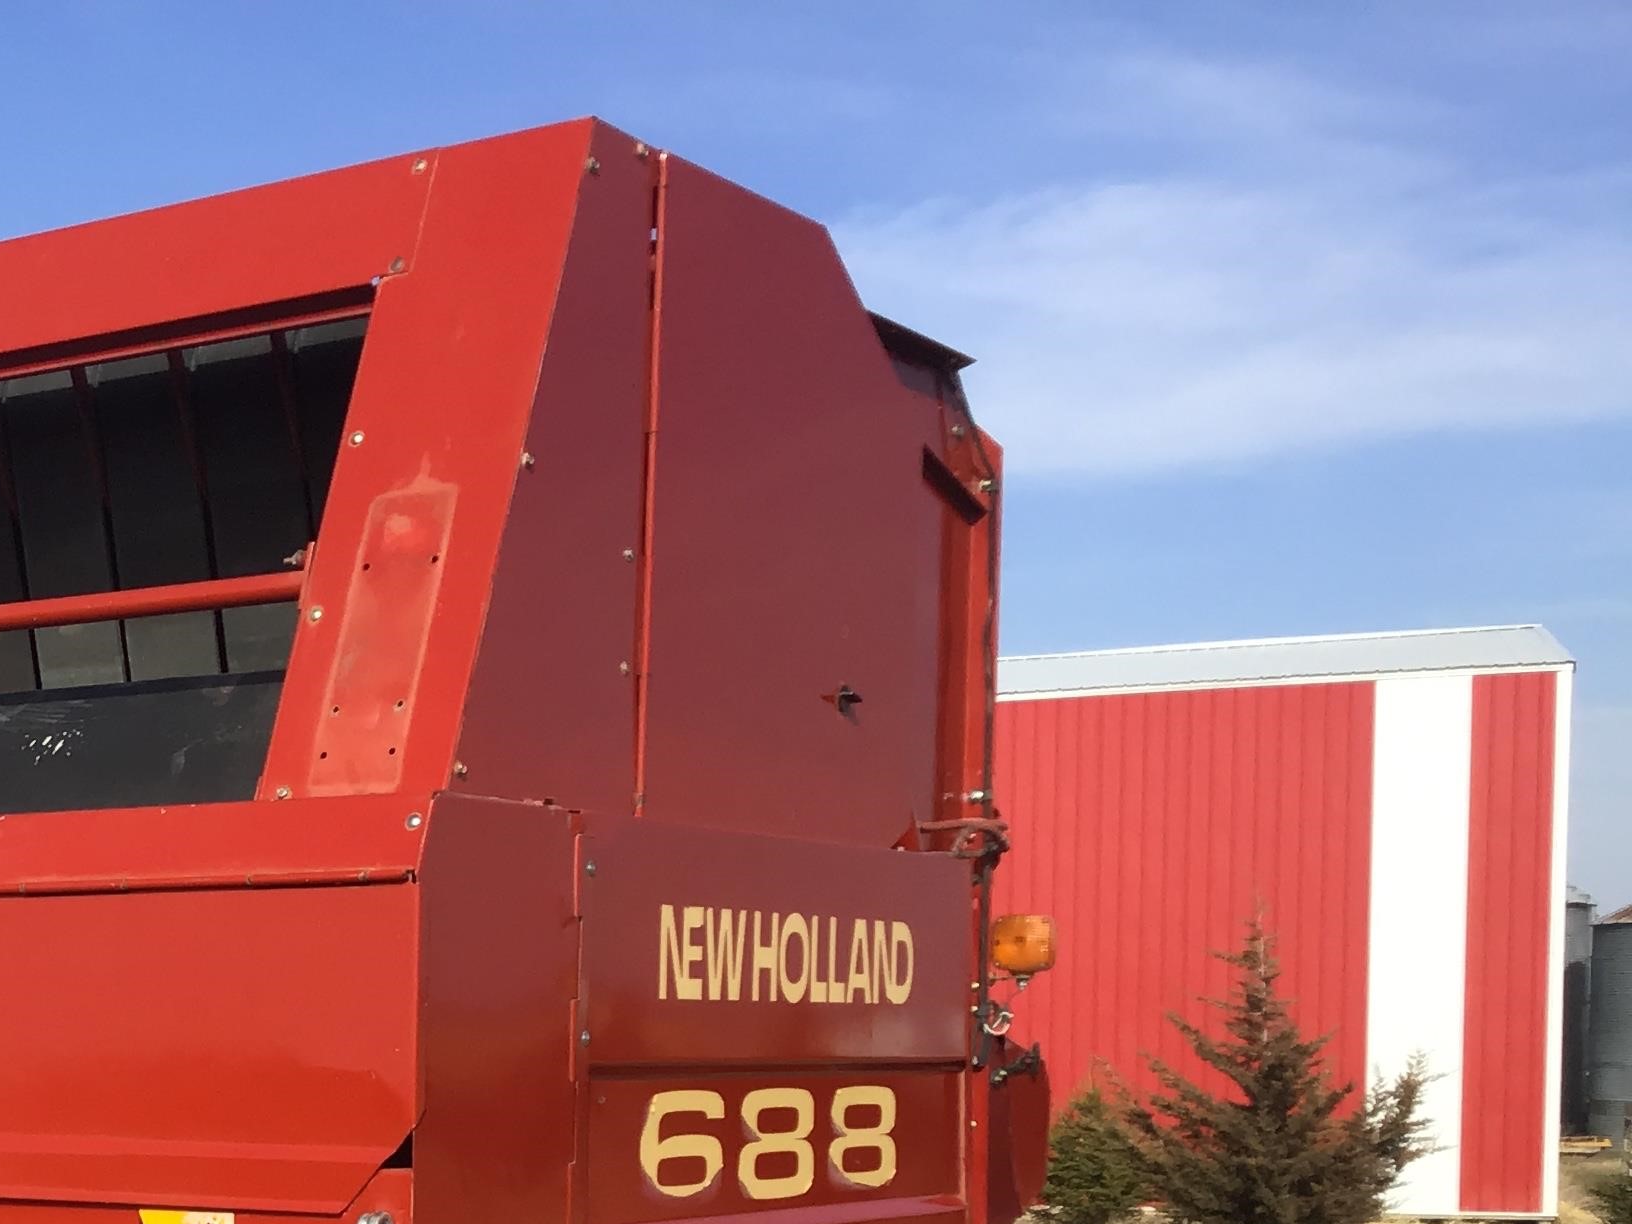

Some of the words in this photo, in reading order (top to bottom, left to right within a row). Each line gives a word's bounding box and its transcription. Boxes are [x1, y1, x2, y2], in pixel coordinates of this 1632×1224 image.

[659, 904, 747, 1000] NEW
[752, 910, 914, 1004] HOLLAND
[639, 1085, 897, 1200] 688
